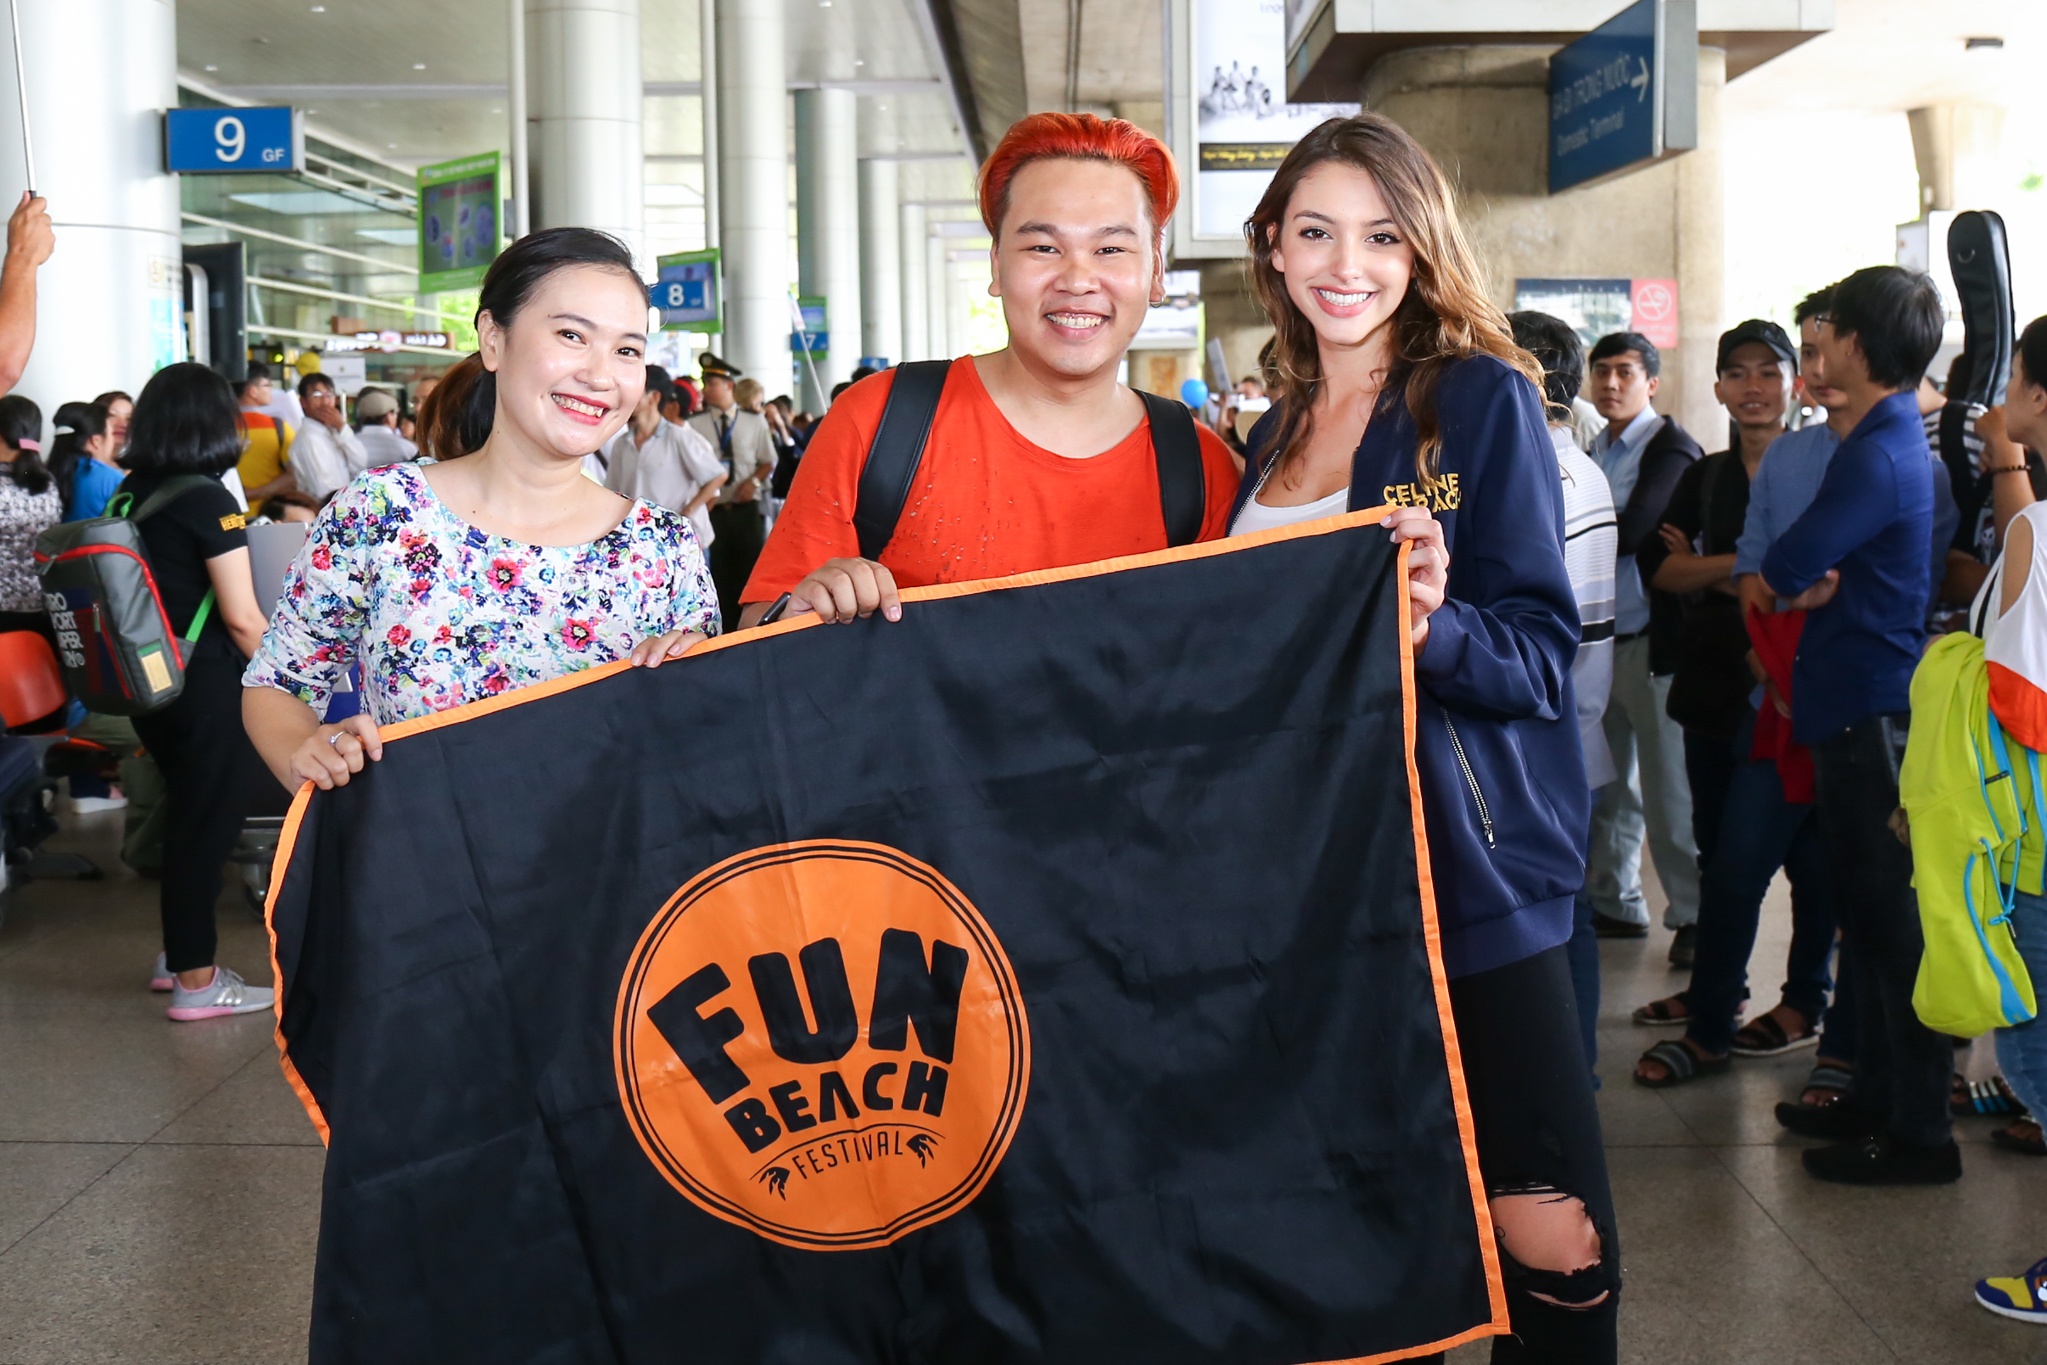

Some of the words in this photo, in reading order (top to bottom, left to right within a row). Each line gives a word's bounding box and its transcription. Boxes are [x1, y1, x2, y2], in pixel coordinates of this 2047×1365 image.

[214, 116, 246, 163] 9
[262, 148, 285, 162] GF
[668, 283, 684, 306] 8
[805, 334, 817, 350] 7
[647, 927, 969, 1105] FUN
[724, 1060, 949, 1154] BEACH
[792, 1130, 903, 1180] FESTIVAL
